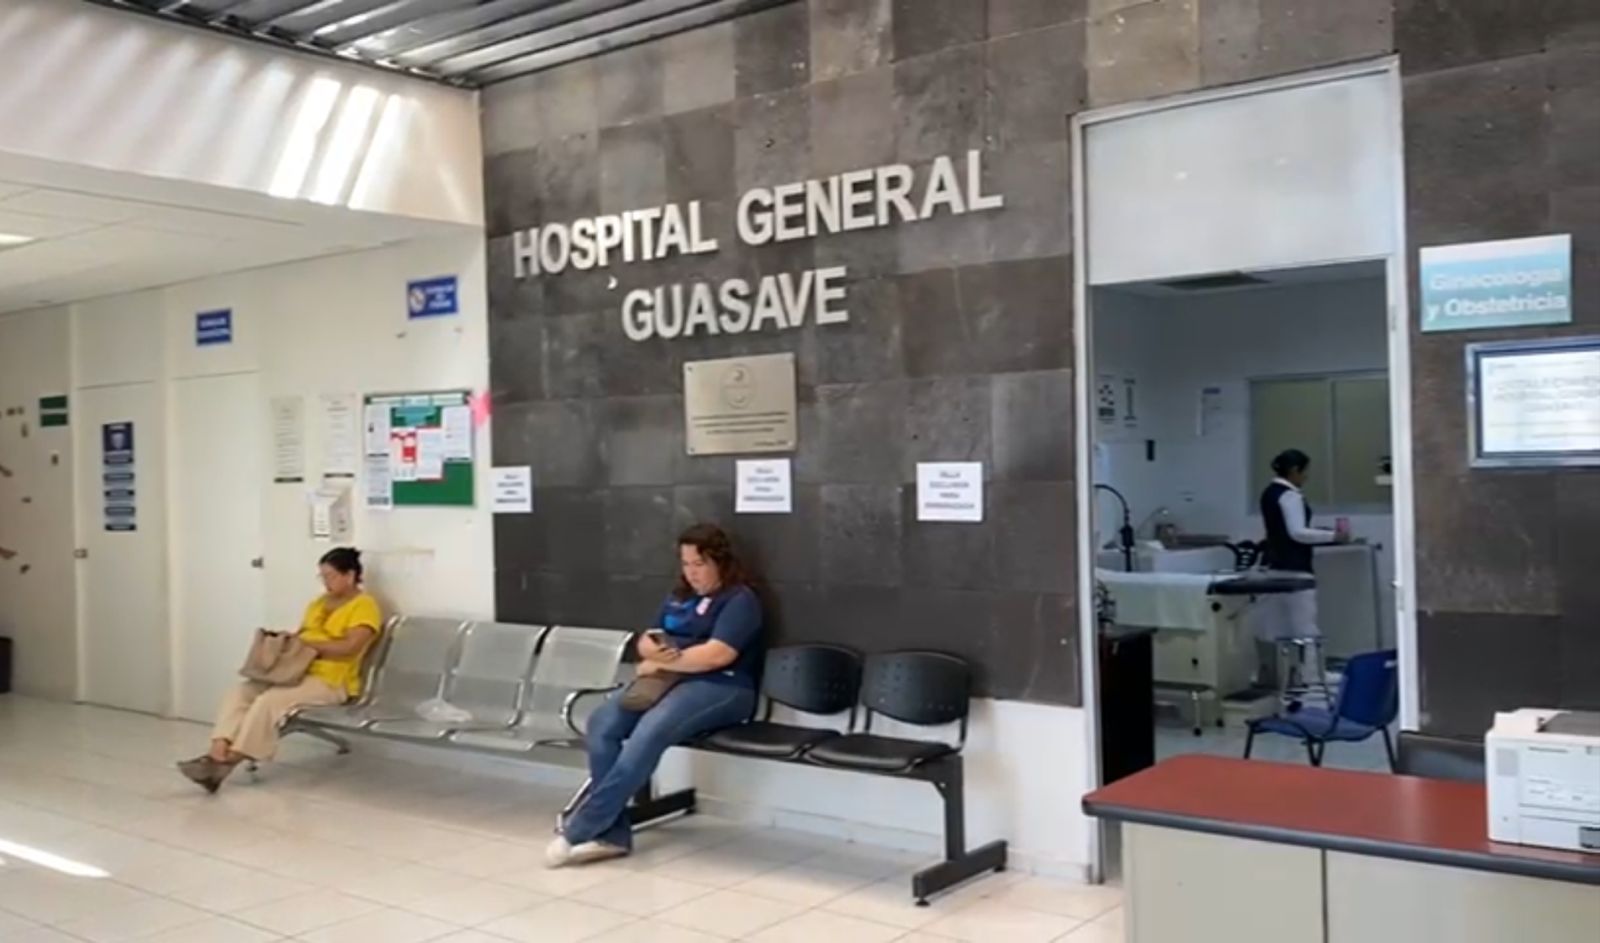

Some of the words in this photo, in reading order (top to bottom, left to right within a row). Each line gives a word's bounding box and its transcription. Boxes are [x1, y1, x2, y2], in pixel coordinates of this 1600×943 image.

[513, 200, 718, 278] HOSPITAL
[737, 150, 1004, 246] GENERAL
[622, 266, 849, 341] GUASAVE
[1426, 304, 1440, 322] y
[1444, 292, 1568, 316] Obstetricia
